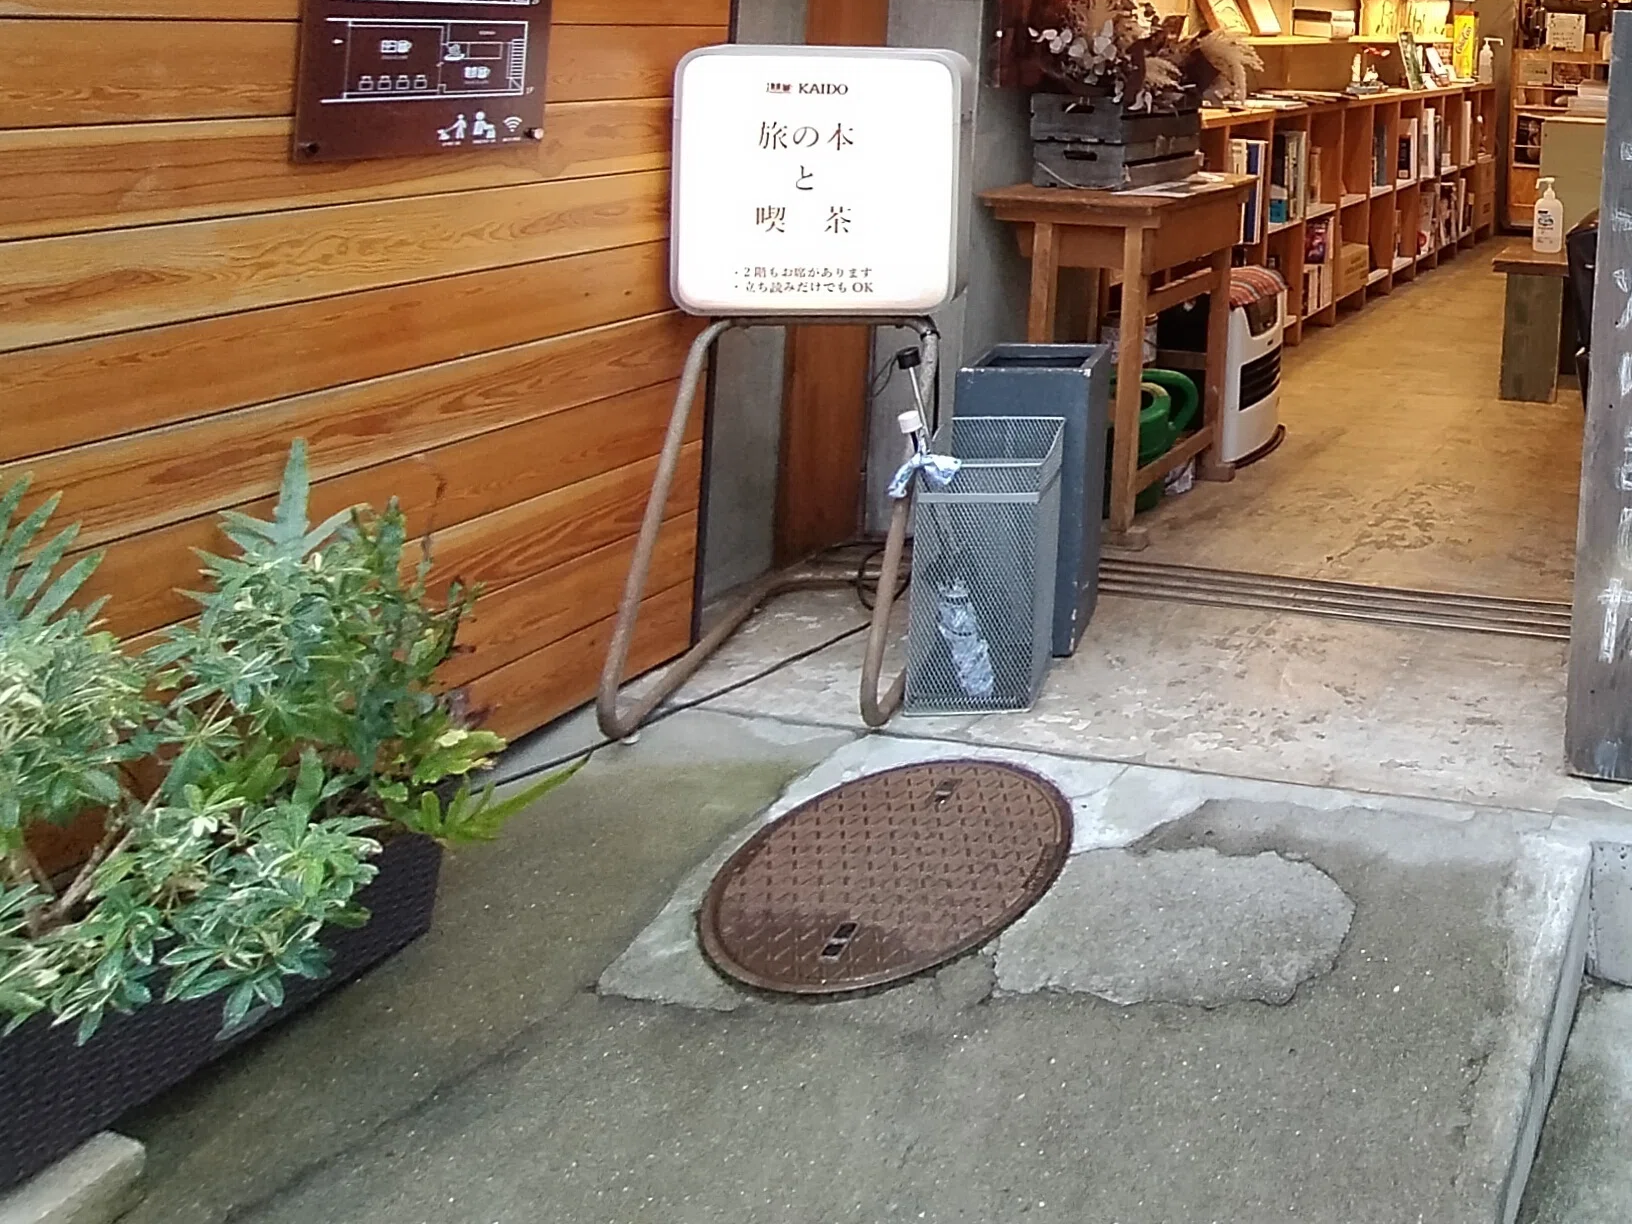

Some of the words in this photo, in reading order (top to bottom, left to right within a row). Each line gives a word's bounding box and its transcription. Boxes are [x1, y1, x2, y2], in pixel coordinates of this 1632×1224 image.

[798, 83, 849, 95] KAIDO
[758, 121, 854, 151] 旅の本
[795, 165, 814, 191] と
[756, 204, 852, 234] 喫茶
